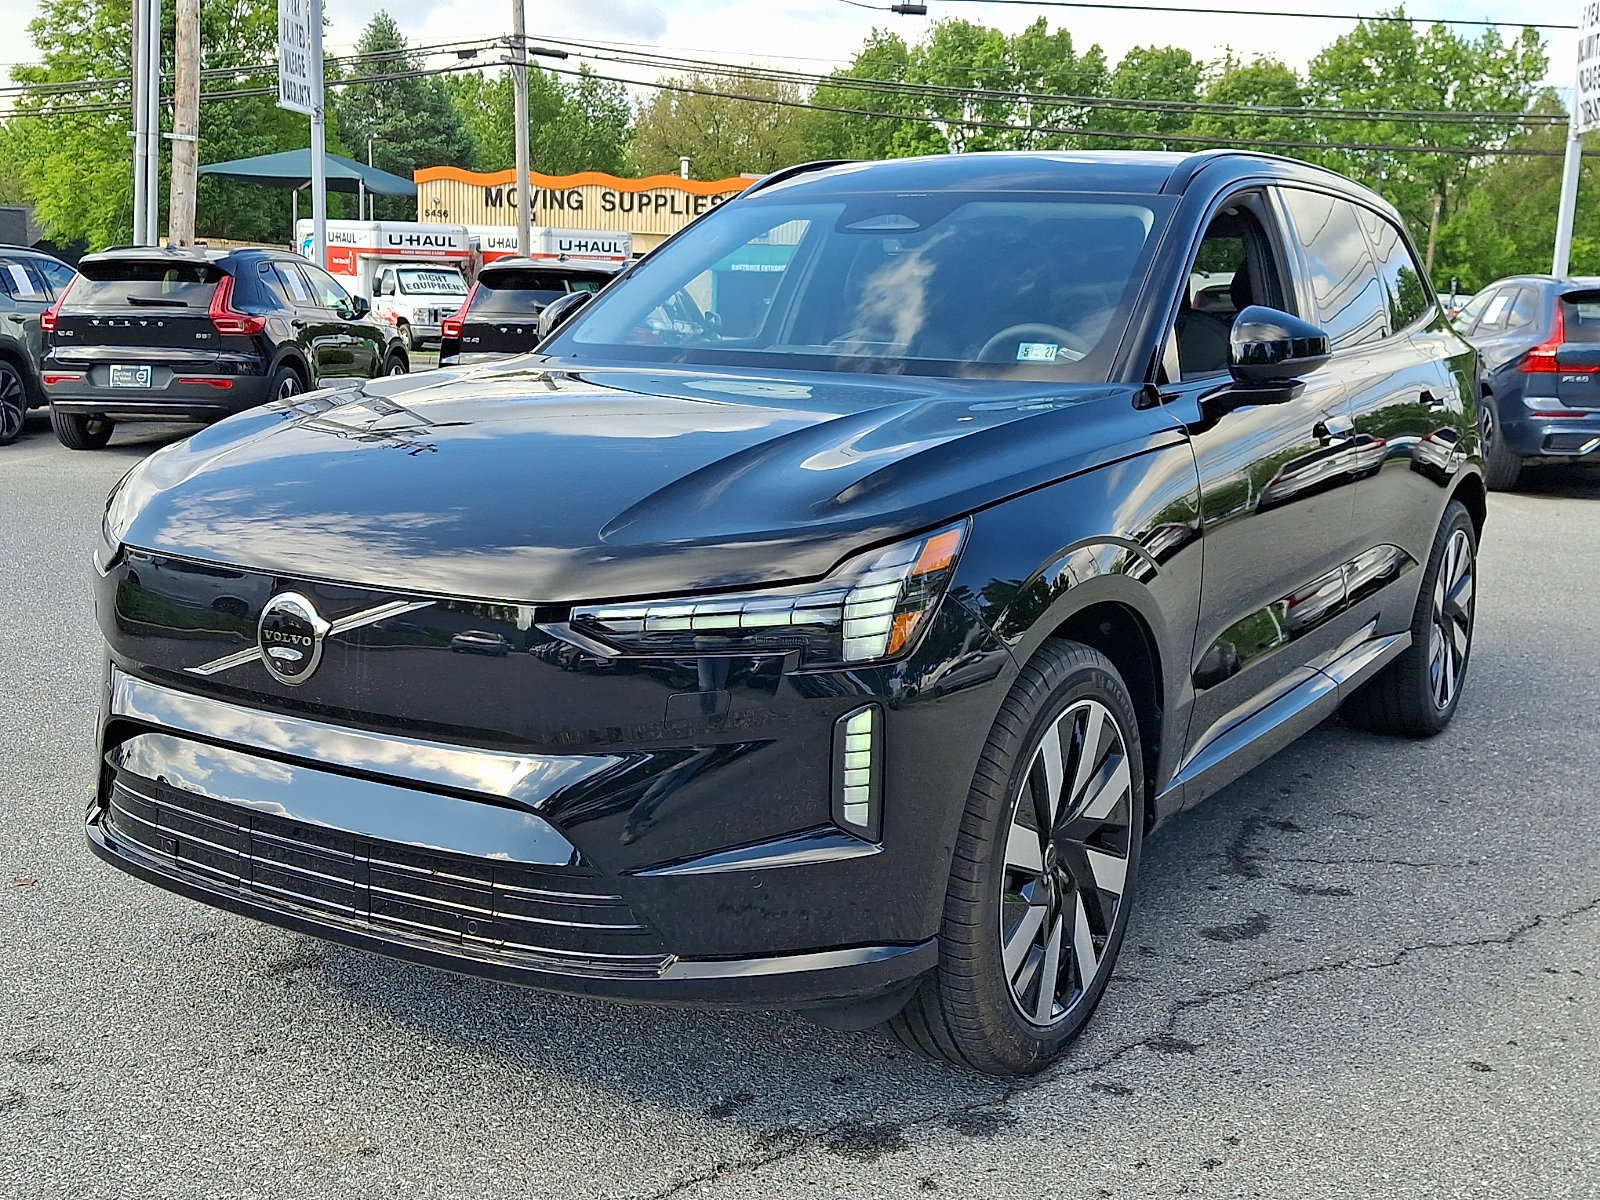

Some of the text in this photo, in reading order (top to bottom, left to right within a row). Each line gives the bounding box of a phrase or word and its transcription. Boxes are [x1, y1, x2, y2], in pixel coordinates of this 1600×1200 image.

[425, 209, 449, 218] 5456
[487, 237, 518, 249] U-HAU
[731, 264, 787, 272] CUSTOMER ENTRANC
[417, 273, 448, 283] RIGHT
[405, 282, 465, 292] EQUIPMENT
[91, 319, 165, 328] VOLVO
[1045, 346, 1055, 358] 27
[263, 629, 312, 647] VOLVO
